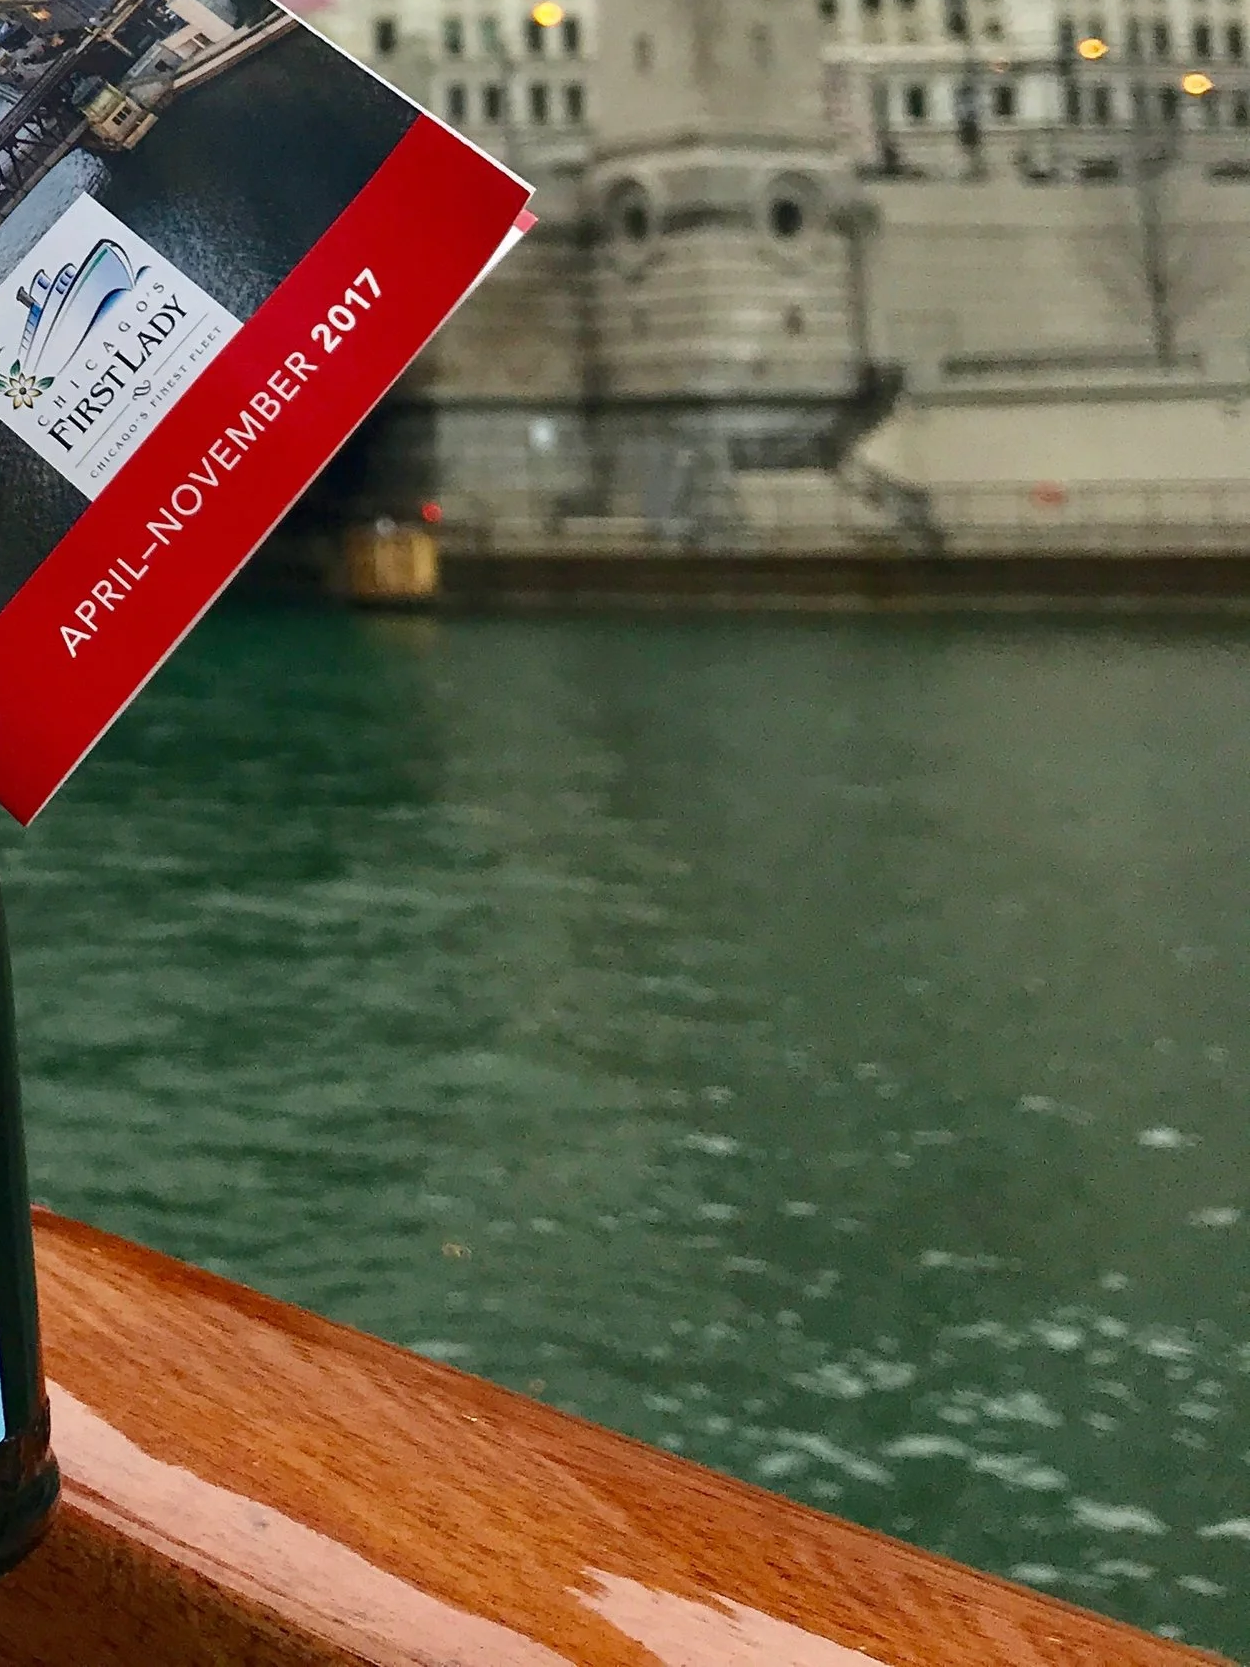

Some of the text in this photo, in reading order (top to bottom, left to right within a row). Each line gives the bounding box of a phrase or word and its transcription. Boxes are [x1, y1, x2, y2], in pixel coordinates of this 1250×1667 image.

[36, 282, 166, 427] CHICAGO'S
[47, 294, 188, 452] FIRST LADY
[310, 268, 383, 354] 2017
[90, 325, 222, 478] CHICAGO'S FINEST FLEET
